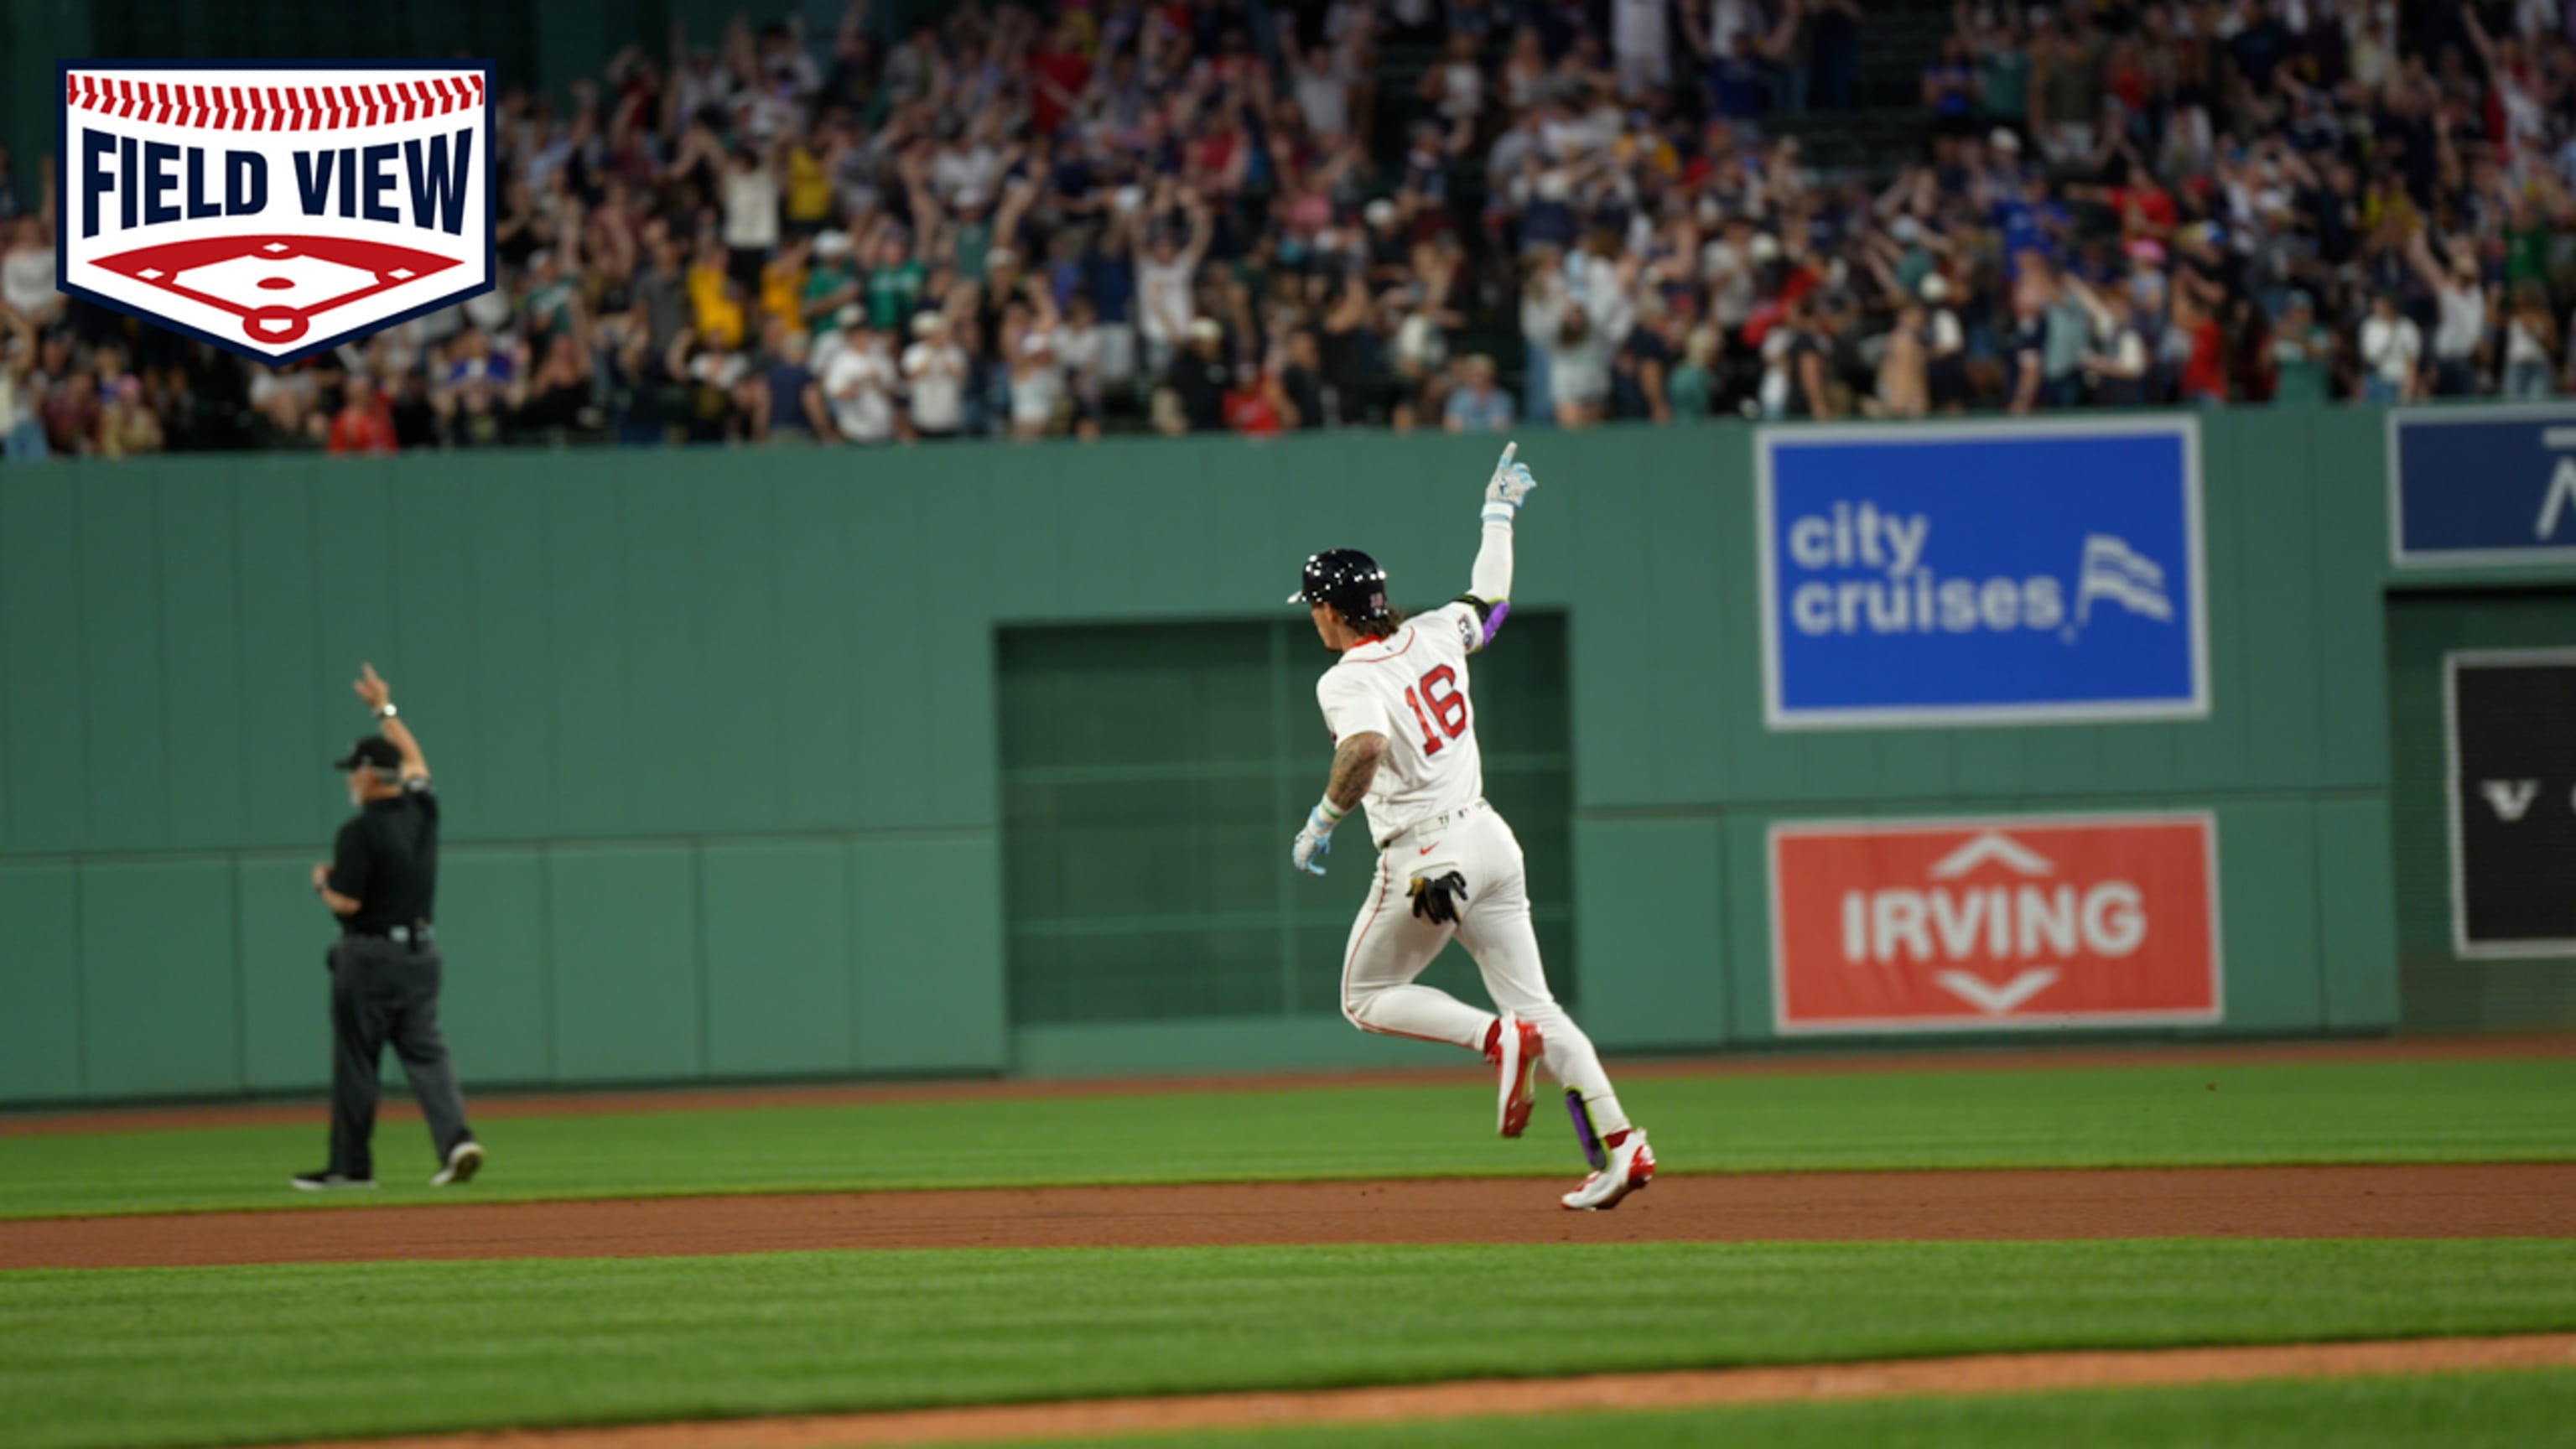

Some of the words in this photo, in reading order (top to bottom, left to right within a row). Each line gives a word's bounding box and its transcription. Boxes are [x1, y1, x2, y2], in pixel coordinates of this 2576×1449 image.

[1789, 501, 1929, 576] city
[1791, 569, 2064, 635] cruises
[1405, 663, 1467, 756] 16
[1842, 880, 2147, 963] IRVING
